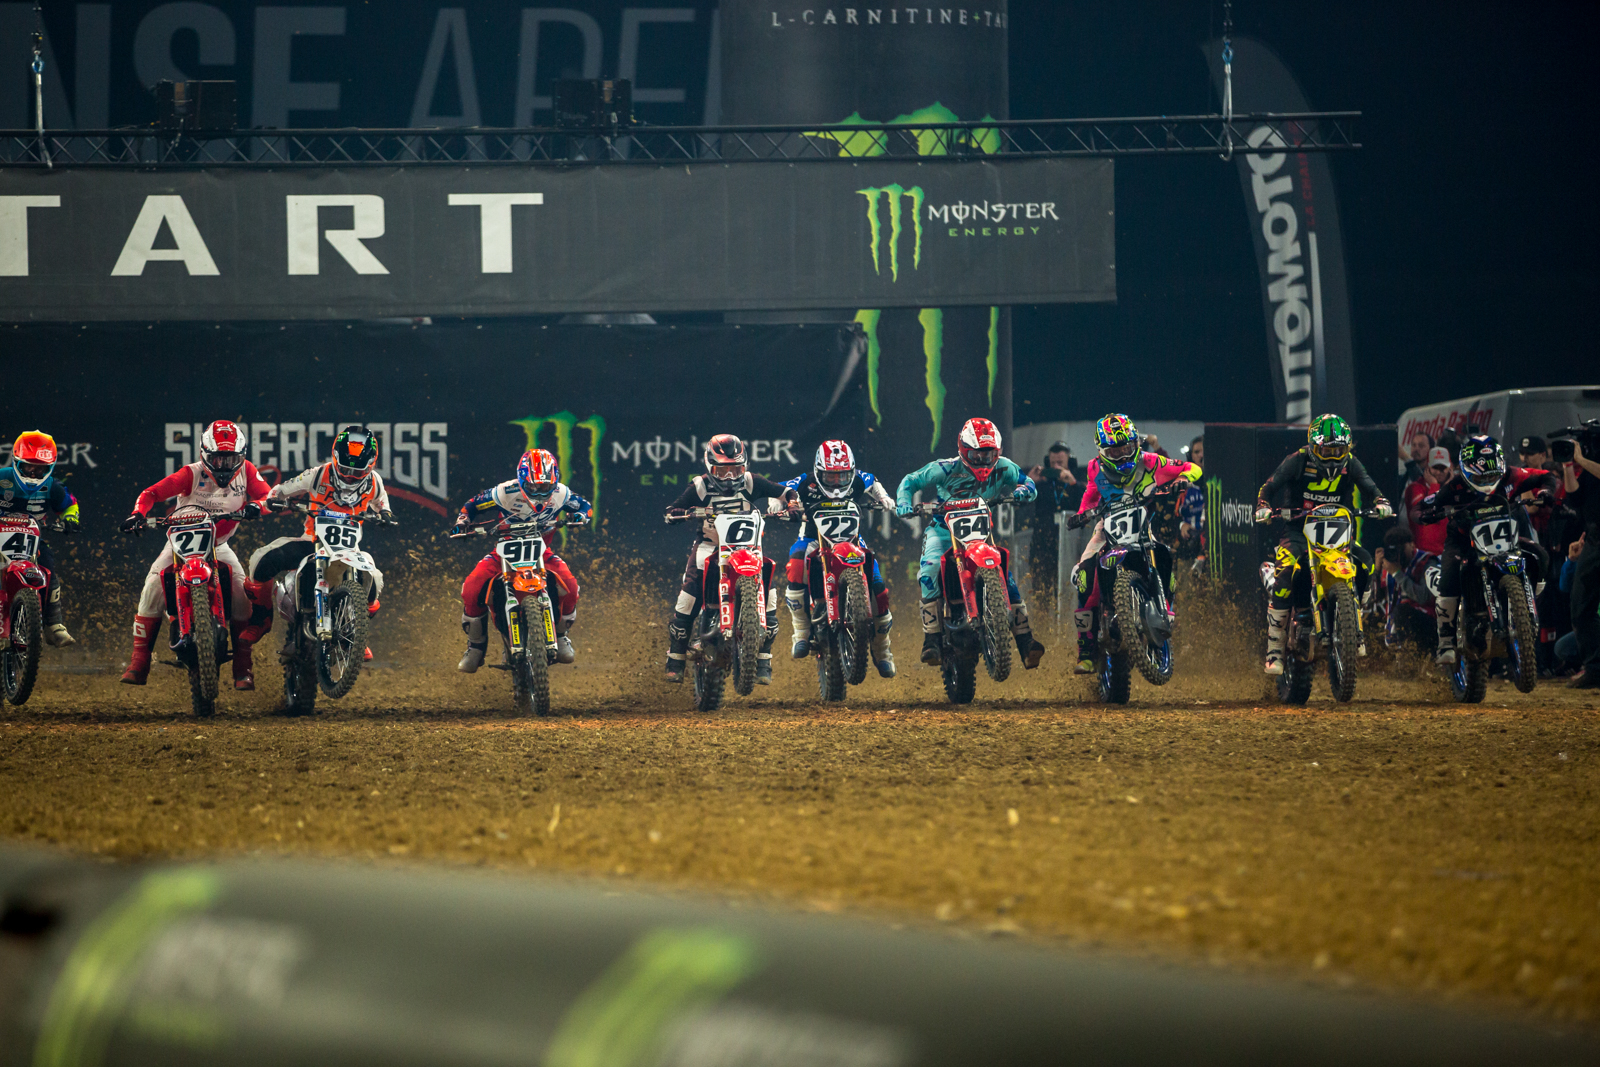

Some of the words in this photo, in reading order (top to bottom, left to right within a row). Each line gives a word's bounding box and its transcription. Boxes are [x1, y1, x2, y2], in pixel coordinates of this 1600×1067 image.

[928, 200, 1059, 224] MONSTER
[0, 192, 544, 277] TART
[949, 226, 1040, 237] ENERGY
[611, 435, 799, 468] MONER
[1302, 492, 1341, 502] SUZUKI
[1111, 508, 1144, 540] 51
[1221, 498, 1254, 528] MONSTER
[1, 526, 35, 535] HONDA
[324, 526, 357, 548] 85
[725, 520, 754, 544] 6
[821, 517, 858, 539] 22
[953, 516, 989, 540] 64
[1227, 531, 1249, 545] ENERGY
[1313, 521, 1350, 546] 17
[1476, 522, 1511, 547] 14
[2, 533, 36, 556] 41
[175, 530, 212, 554] 27
[504, 540, 541, 562] 911
[720, 583, 730, 625] GICO
[756, 584, 766, 627] GEICO
[544, 611, 552, 636] DUNLOP
